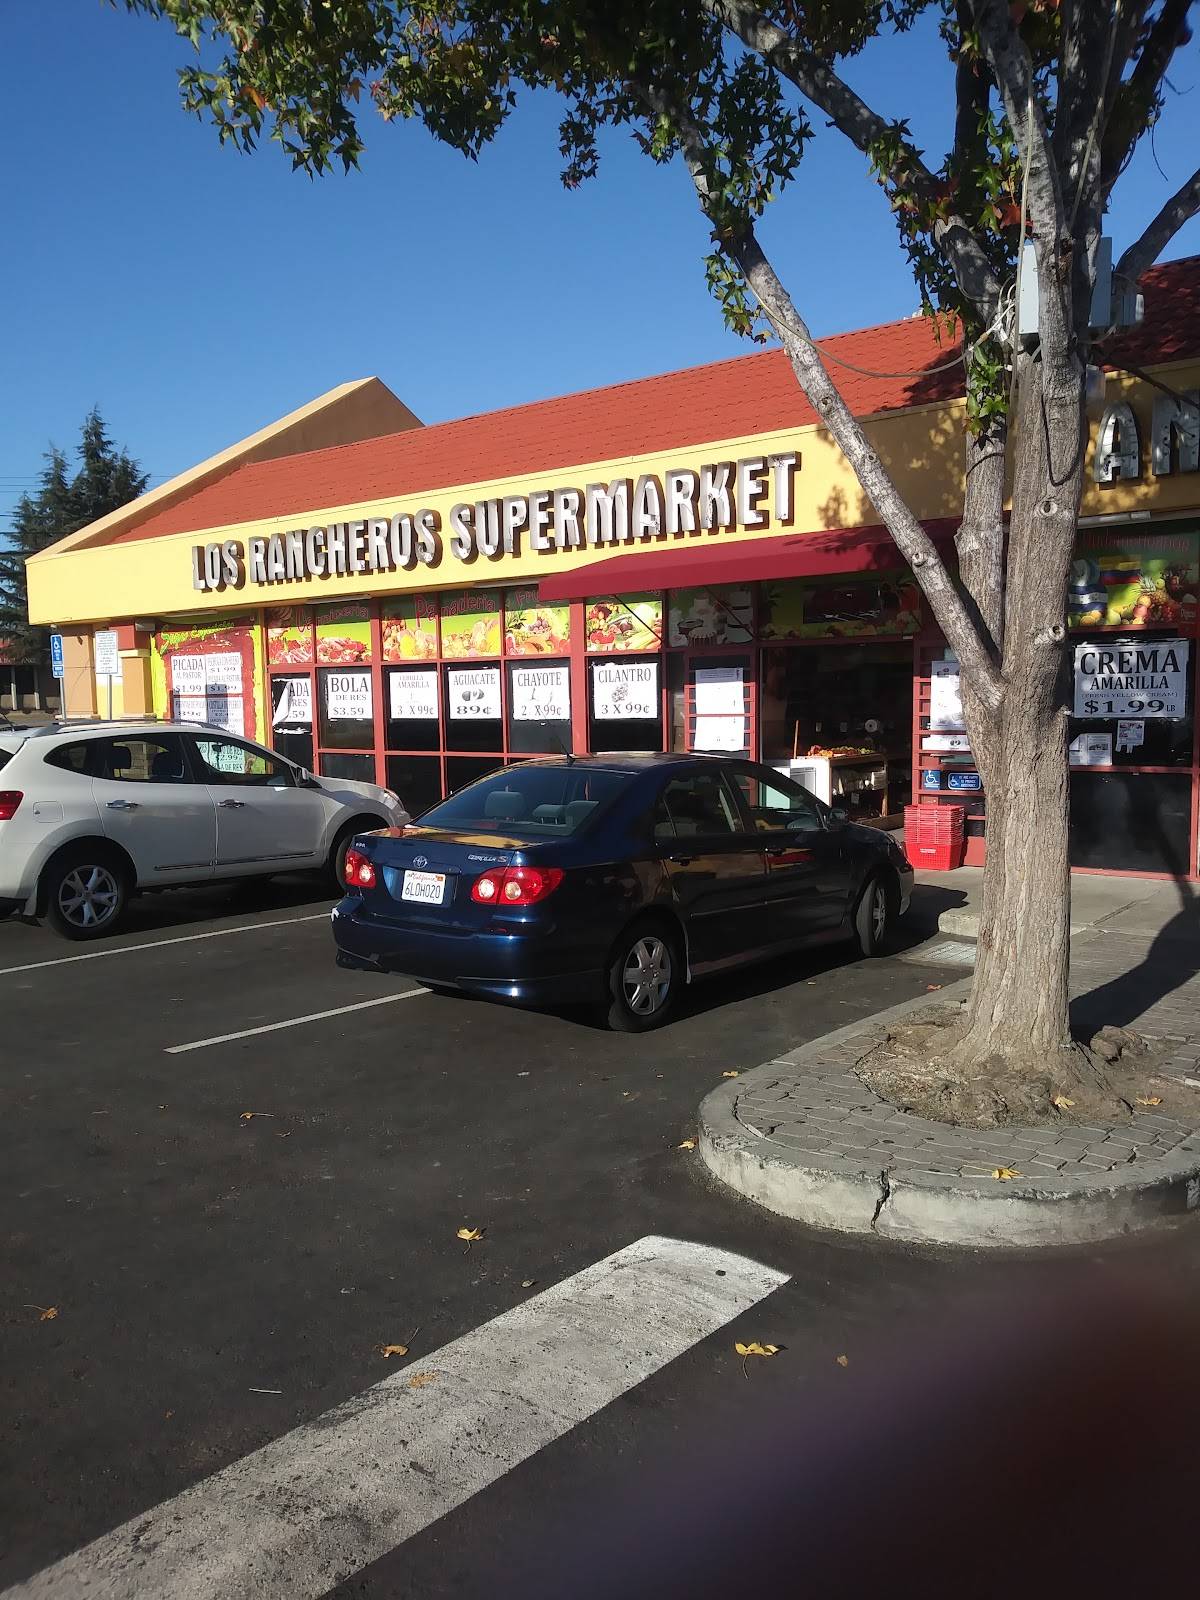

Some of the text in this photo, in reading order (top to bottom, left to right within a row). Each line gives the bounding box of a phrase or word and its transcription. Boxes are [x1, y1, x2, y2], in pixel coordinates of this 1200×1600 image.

[190, 451, 801, 591] LOS RANCHEROS SUPERMARKET
[173, 658, 204, 671] PICADA
[1080, 649, 1181, 675] CREMA
[453, 673, 496, 686] AGUACATE
[517, 672, 562, 687] CHAYOTE
[598, 668, 652, 683] CILANTRO
[175, 684, 202, 693] $1.99
[289, 681, 309, 697] ADA
[331, 677, 369, 693] BOLA
[397, 681, 430, 689] AMARILLA
[1090, 676, 1169, 690] AMARILLA
[333, 707, 364, 716] $3.59
[456, 705, 493, 715] 89¢
[521, 705, 527, 716] 2
[601, 704, 609, 715] 3
[613, 704, 621, 714] X
[1084, 699, 1176, 714] $1.99 LB
